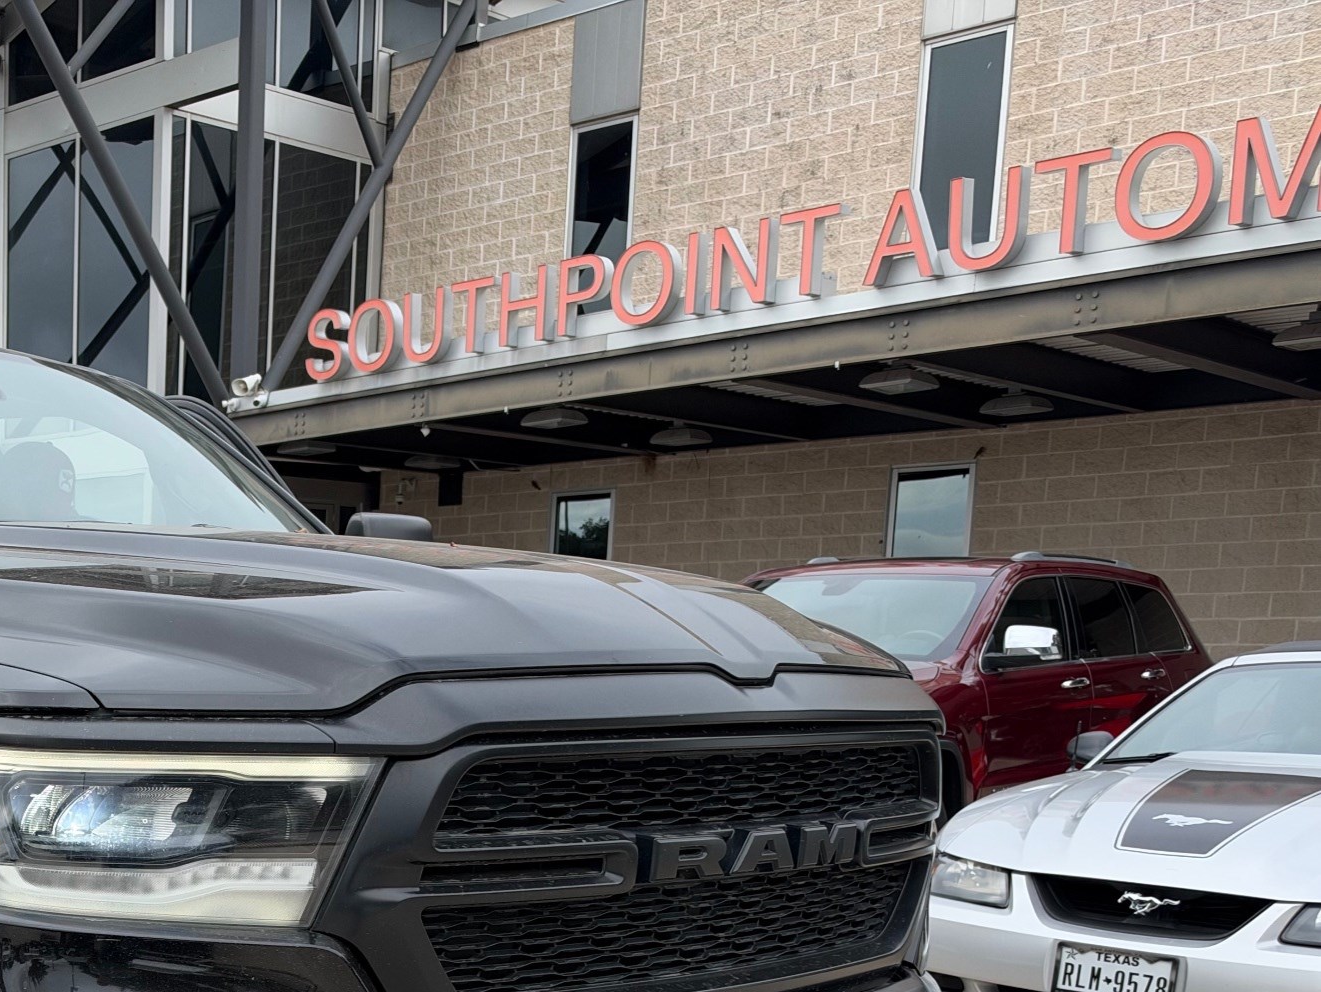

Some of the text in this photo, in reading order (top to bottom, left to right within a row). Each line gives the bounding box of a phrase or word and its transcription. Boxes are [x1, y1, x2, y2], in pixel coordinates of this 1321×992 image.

[304, 202, 852, 383] SOUTHPOINT
[650, 821, 857, 883] RAM
[1096, 951, 1140, 967] TEXAS
